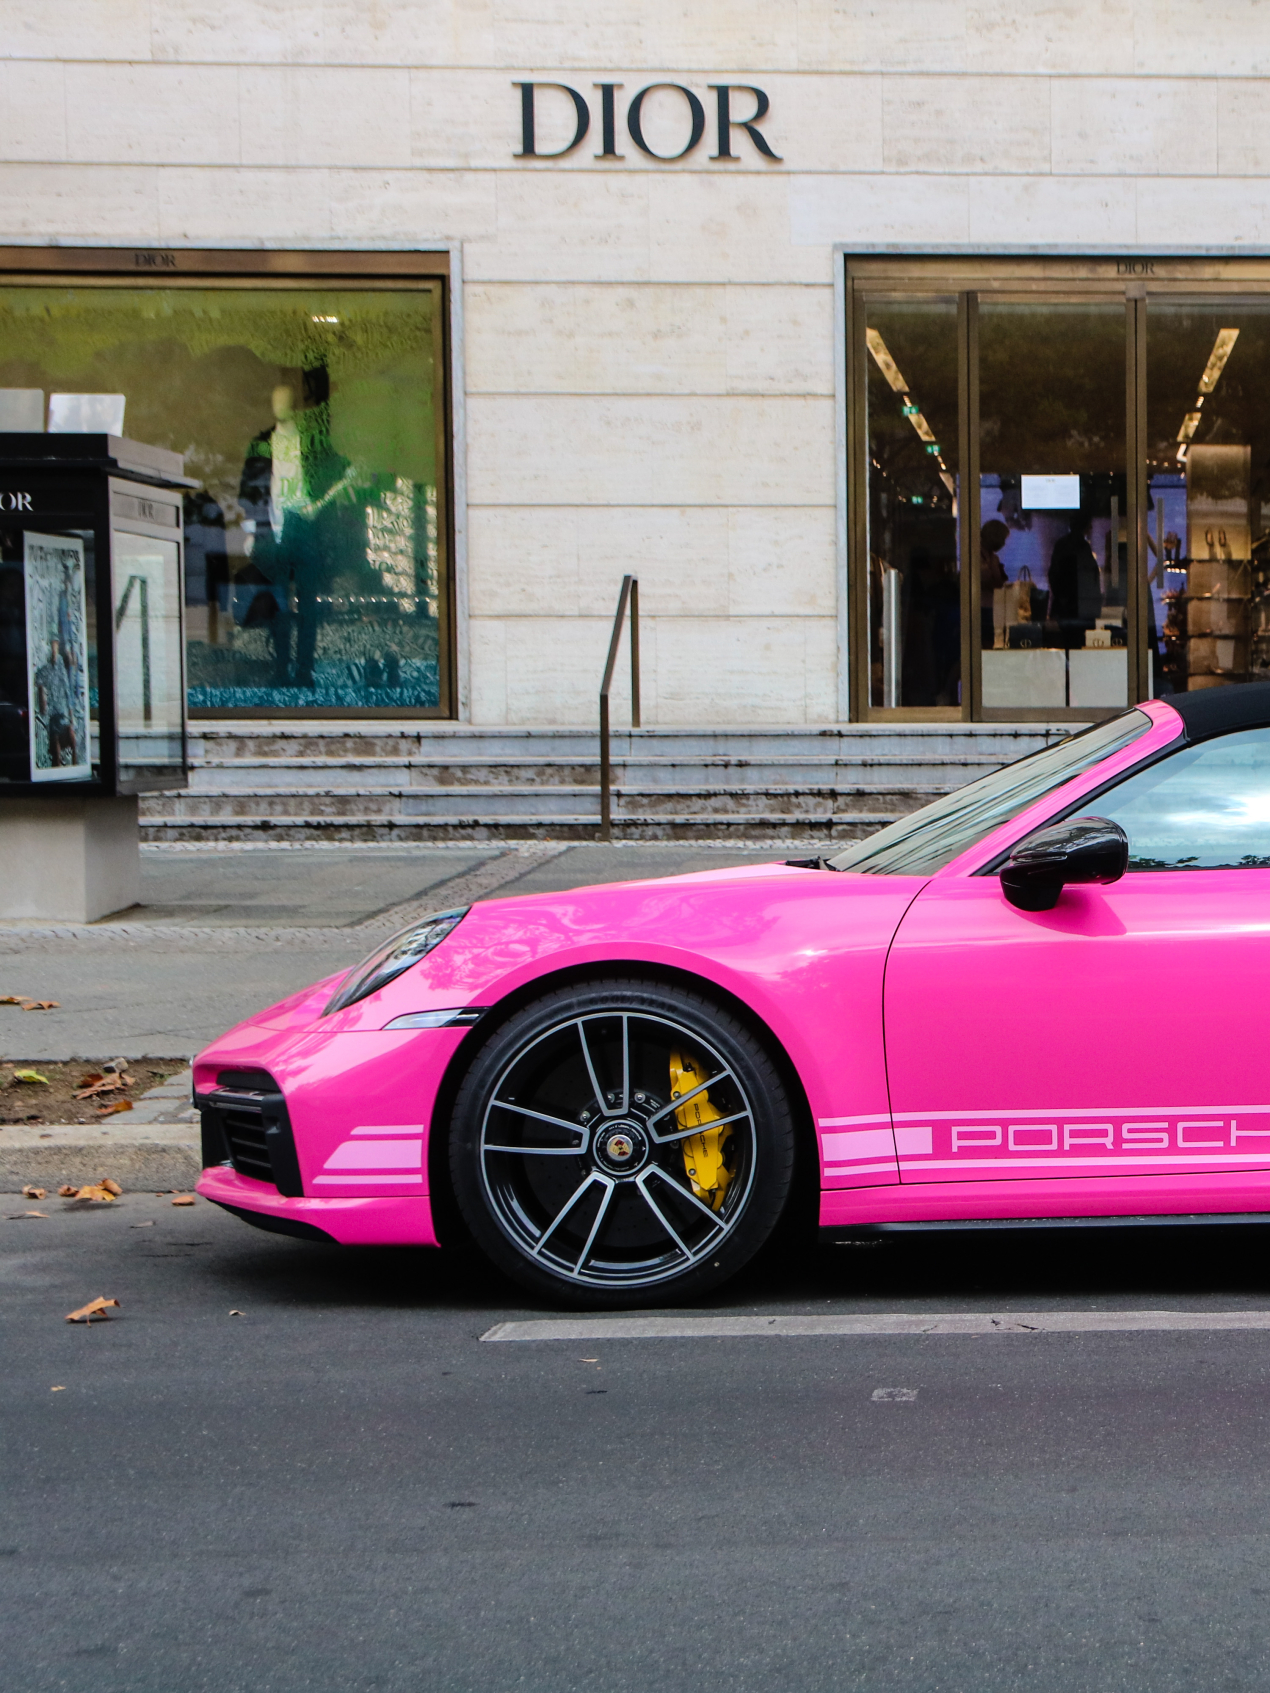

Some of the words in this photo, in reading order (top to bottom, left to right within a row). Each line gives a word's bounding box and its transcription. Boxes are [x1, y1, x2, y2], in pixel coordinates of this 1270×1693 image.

[512, 81, 783, 161] DIOR
[134, 253, 178, 268] DIOR
[1116, 260, 1156, 275] DIOR
[0, 491, 34, 511] OR
